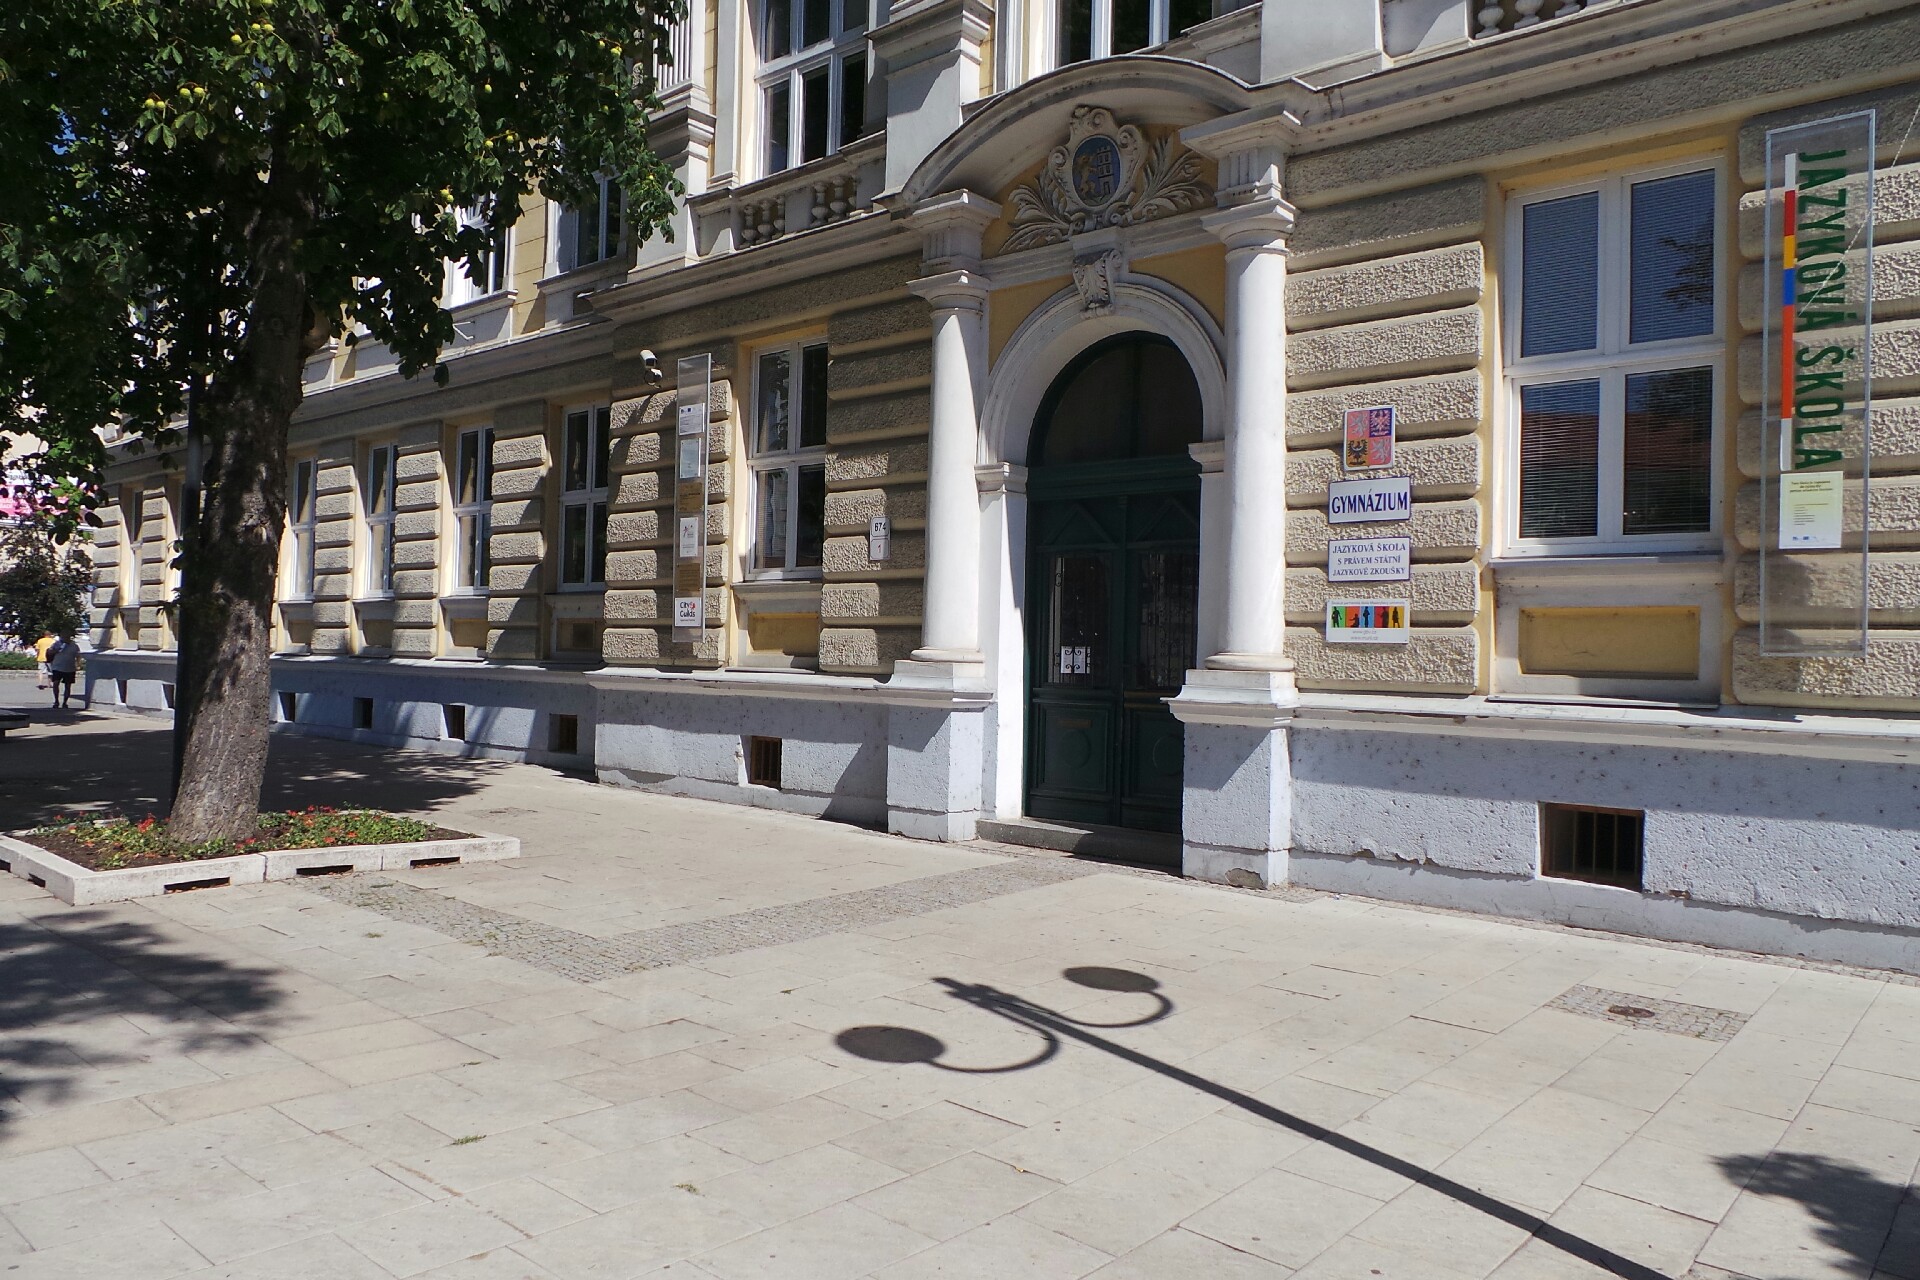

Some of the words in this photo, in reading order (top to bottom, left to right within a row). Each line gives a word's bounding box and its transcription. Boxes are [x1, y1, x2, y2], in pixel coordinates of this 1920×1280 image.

[1797, 150, 1857, 332] JAZYKOVÁ
[1795, 345, 1855, 470] ŠKOLA
[1331, 488, 1408, 514] GYMNÁZIUM
[874, 522, 886, 532] 674
[1332, 543, 1375, 554] JAZYKOVÁ
[1376, 542, 1406, 552] ŠKOLA
[1337, 558, 1342, 566] S
[1343, 556, 1372, 565] PRÁVEM
[1374, 554, 1401, 564] STÁTNÍ
[1332, 567, 1369, 576] JAZYKOVÉ
[1369, 565, 1406, 575] ZKOUŠKY
